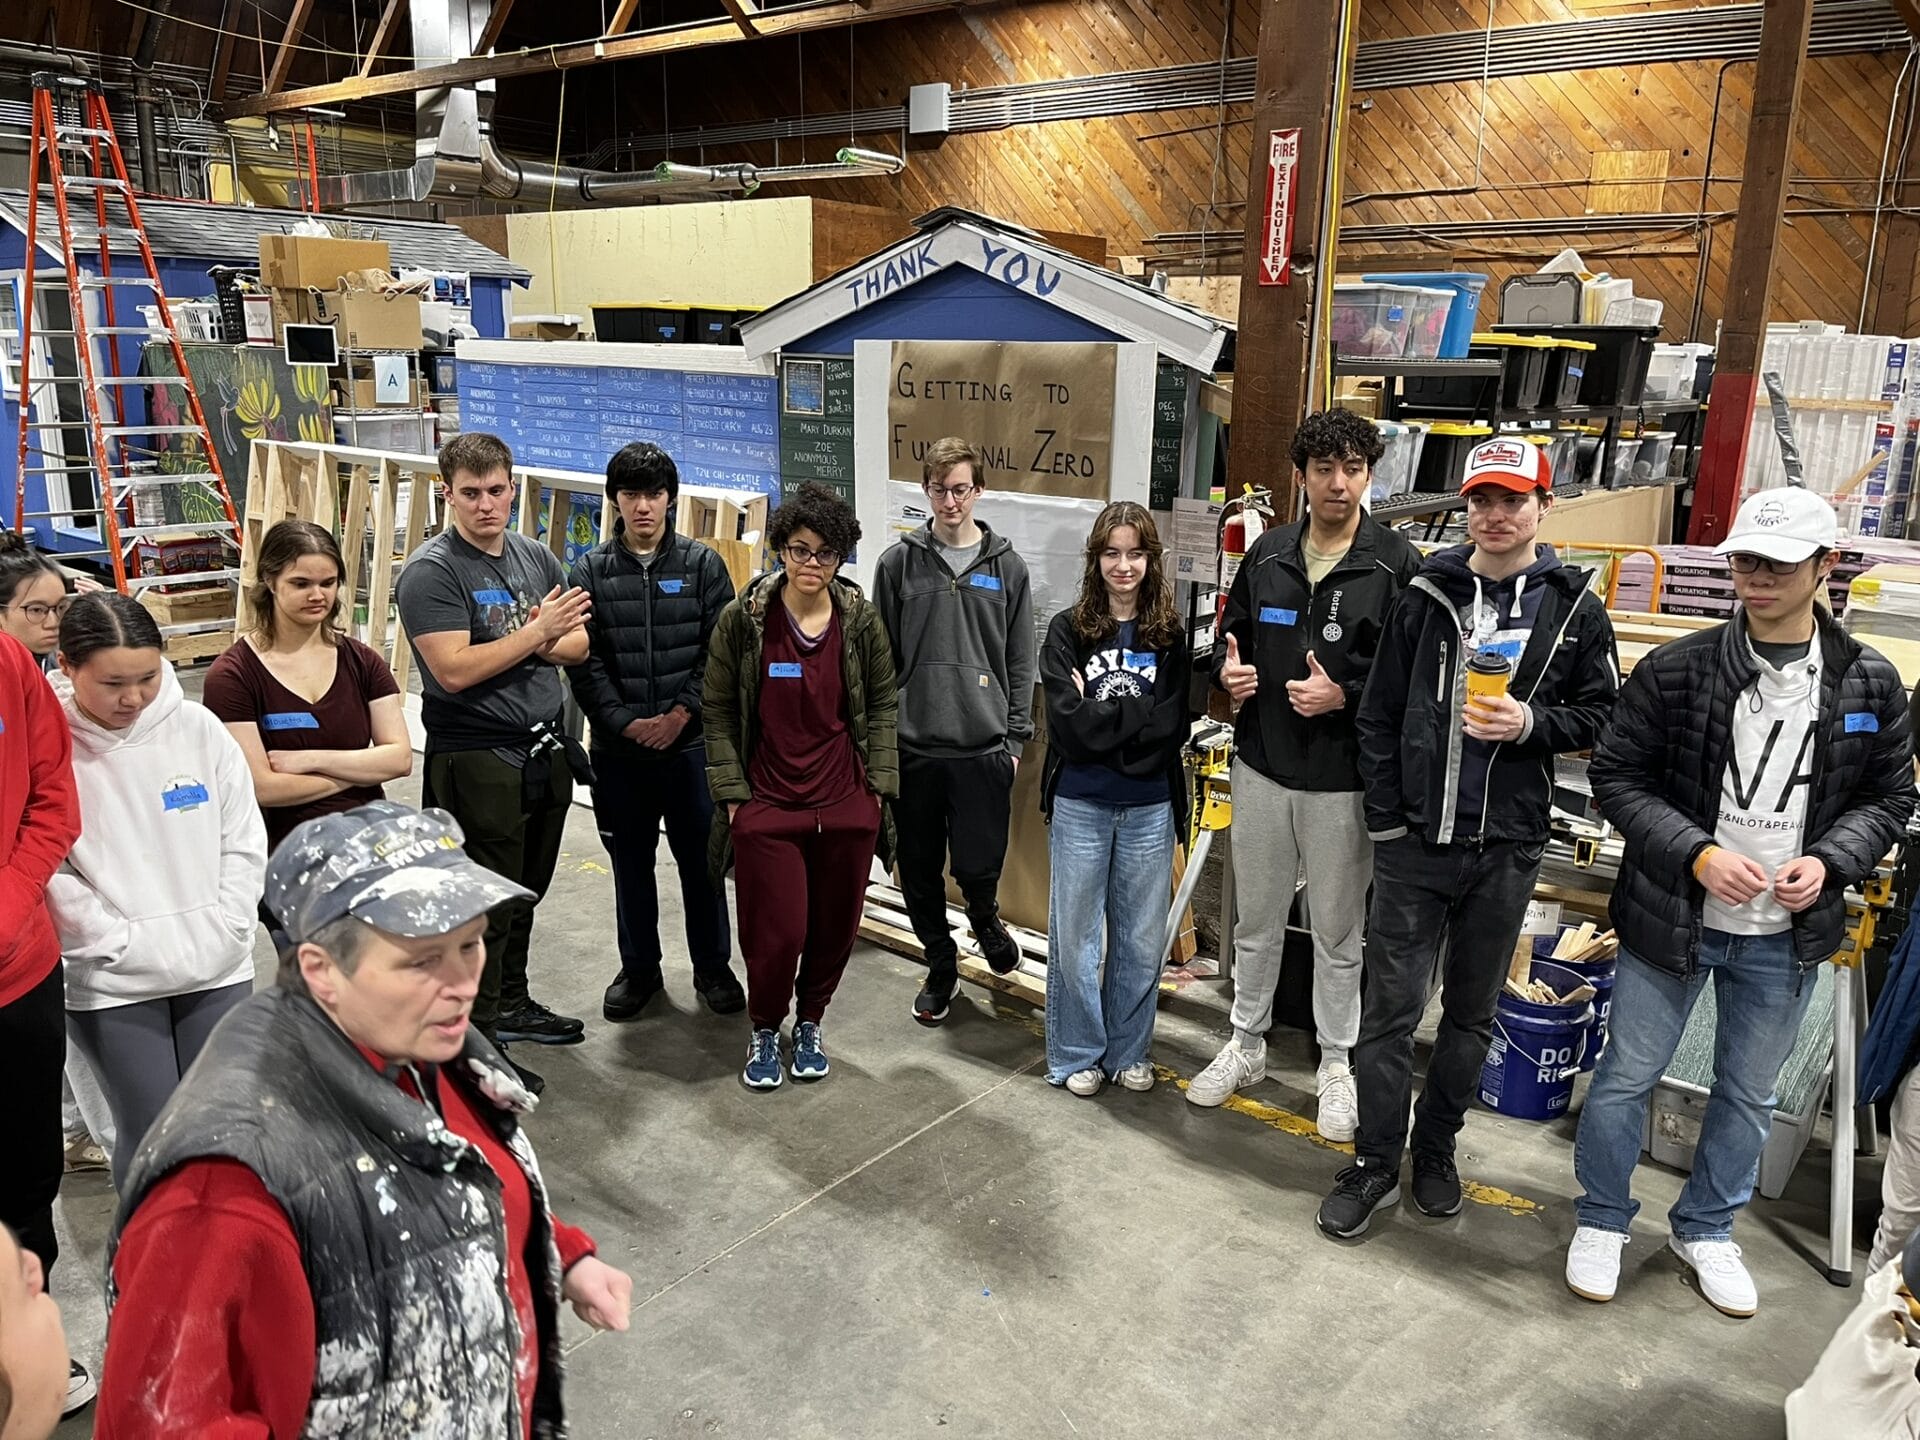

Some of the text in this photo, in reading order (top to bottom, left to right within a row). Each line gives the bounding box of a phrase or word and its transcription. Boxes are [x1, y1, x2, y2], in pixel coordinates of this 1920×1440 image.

[1273, 142, 1295, 158] FIRE
[1271, 164, 1287, 272] EXTINGUISHER
[845, 238, 1062, 308] THANK YOU
[387, 373, 398, 387] A
[1044, 383, 1070, 404] TO
[1158, 401, 1176, 411] DEC.
[800, 422, 852, 437] MARY DURKAN
[893, 424, 1018, 471] FUNAL
[793, 452, 838, 466] ANONYMOUS
[731, 472, 760, 486] SEATTLE
[1674, 566, 1710, 577] DURATION
[1674, 586, 1710, 597] DURATION
[1328, 590, 1343, 621] Rotary
[1669, 606, 1704, 616] DURATION
[1540, 1047, 1571, 1066] DO
